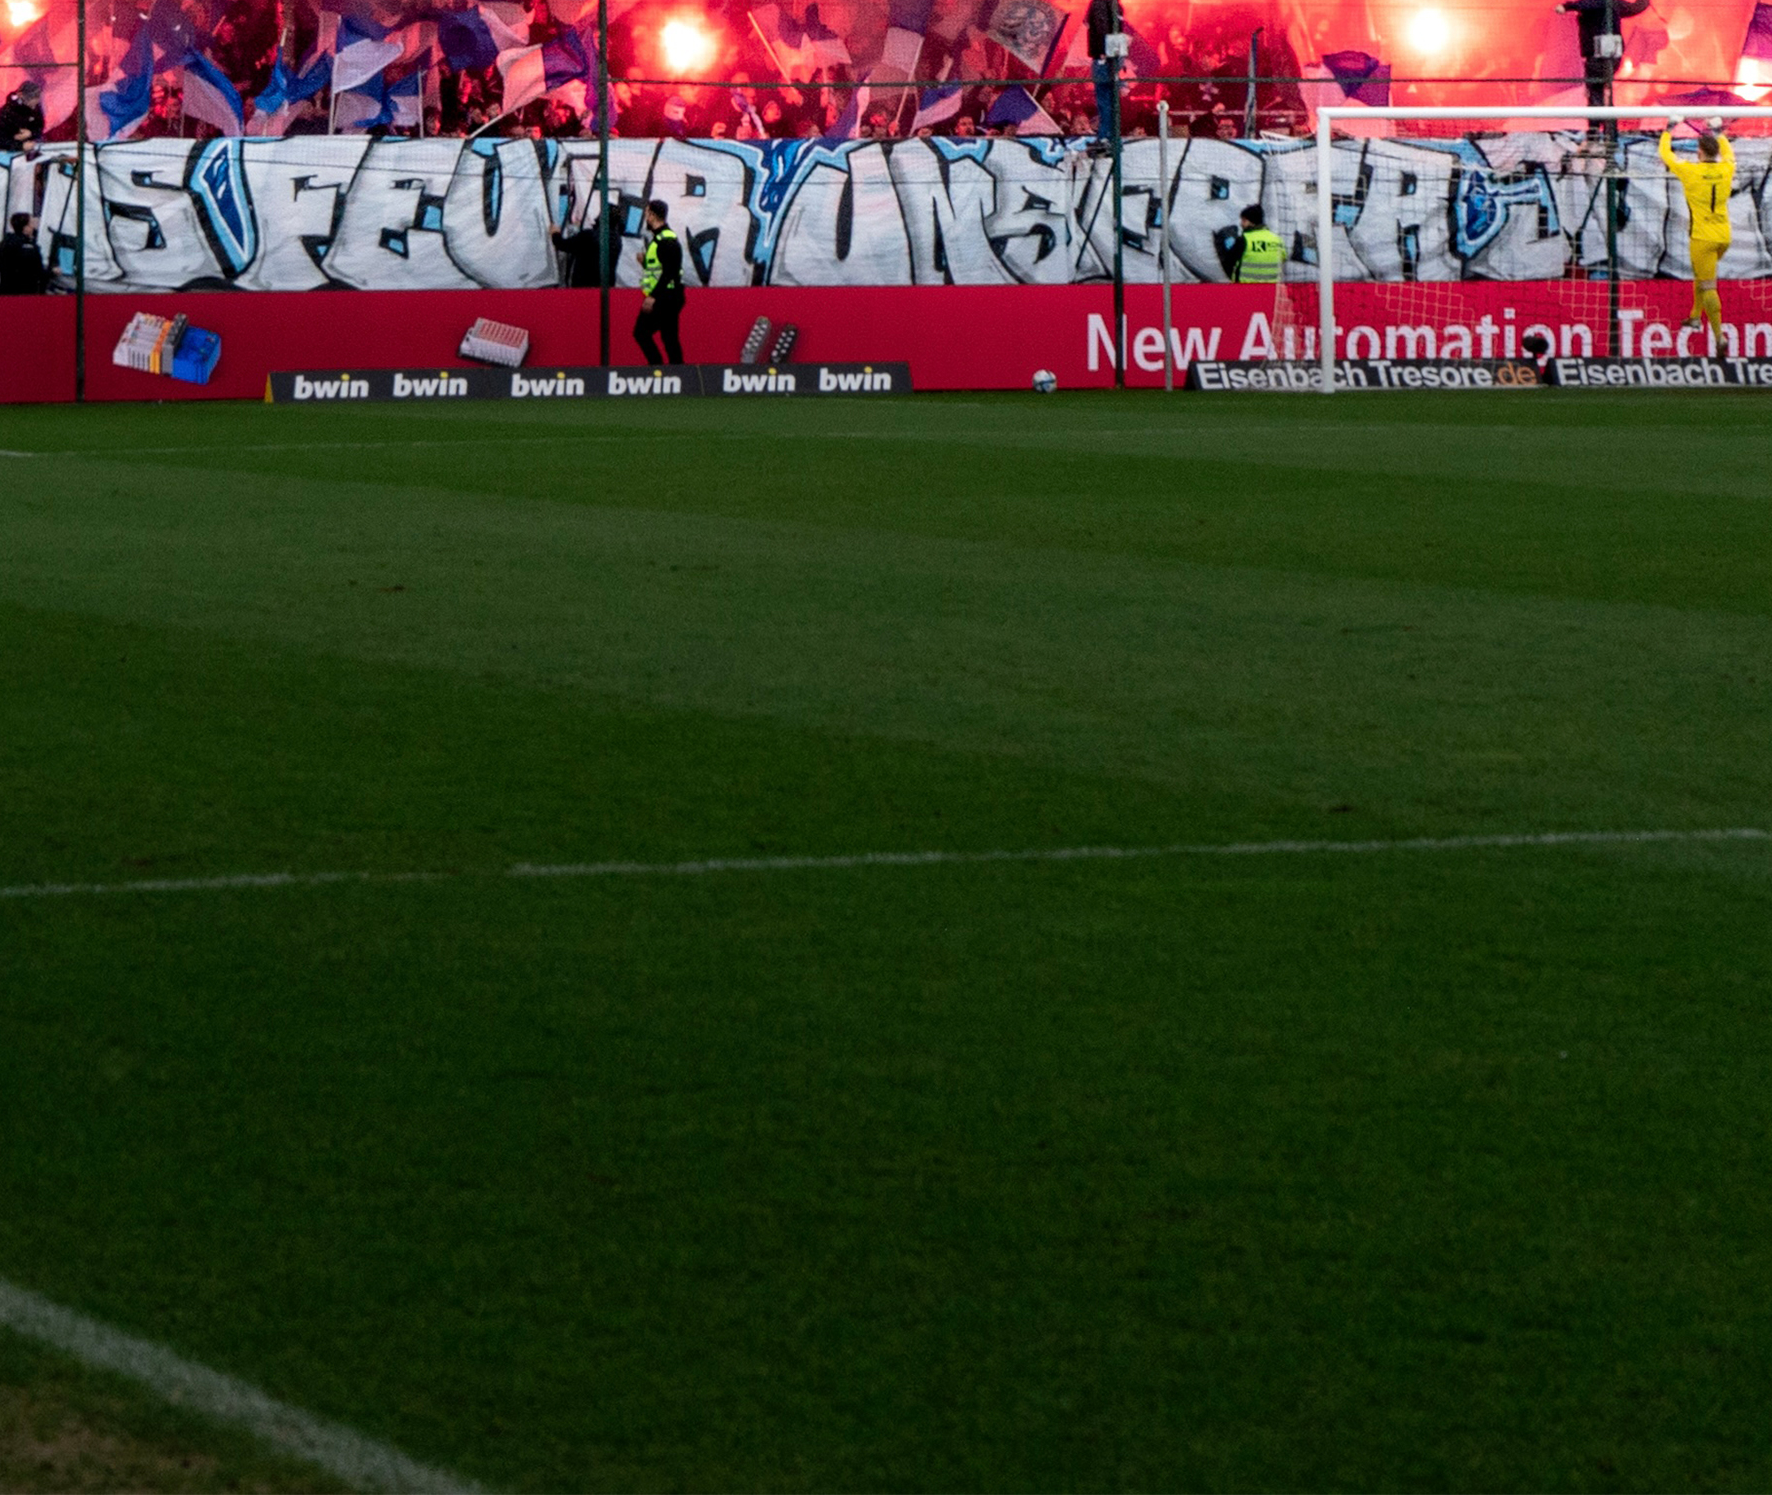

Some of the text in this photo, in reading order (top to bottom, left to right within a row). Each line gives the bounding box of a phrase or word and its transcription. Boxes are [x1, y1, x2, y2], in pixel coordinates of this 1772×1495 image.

[1087, 314, 1223, 372] New
[1239, 308, 1598, 368] Automation
[393, 371, 468, 397] bwin
[511, 372, 584, 397] bwin
[608, 370, 681, 395] bwin
[723, 368, 795, 392] bwin
[819, 366, 891, 391] bwin
[1371, 360, 1538, 388] Tresore.de
[1556, 358, 1729, 386] Eisenbach
[294, 373, 369, 399] bwin
